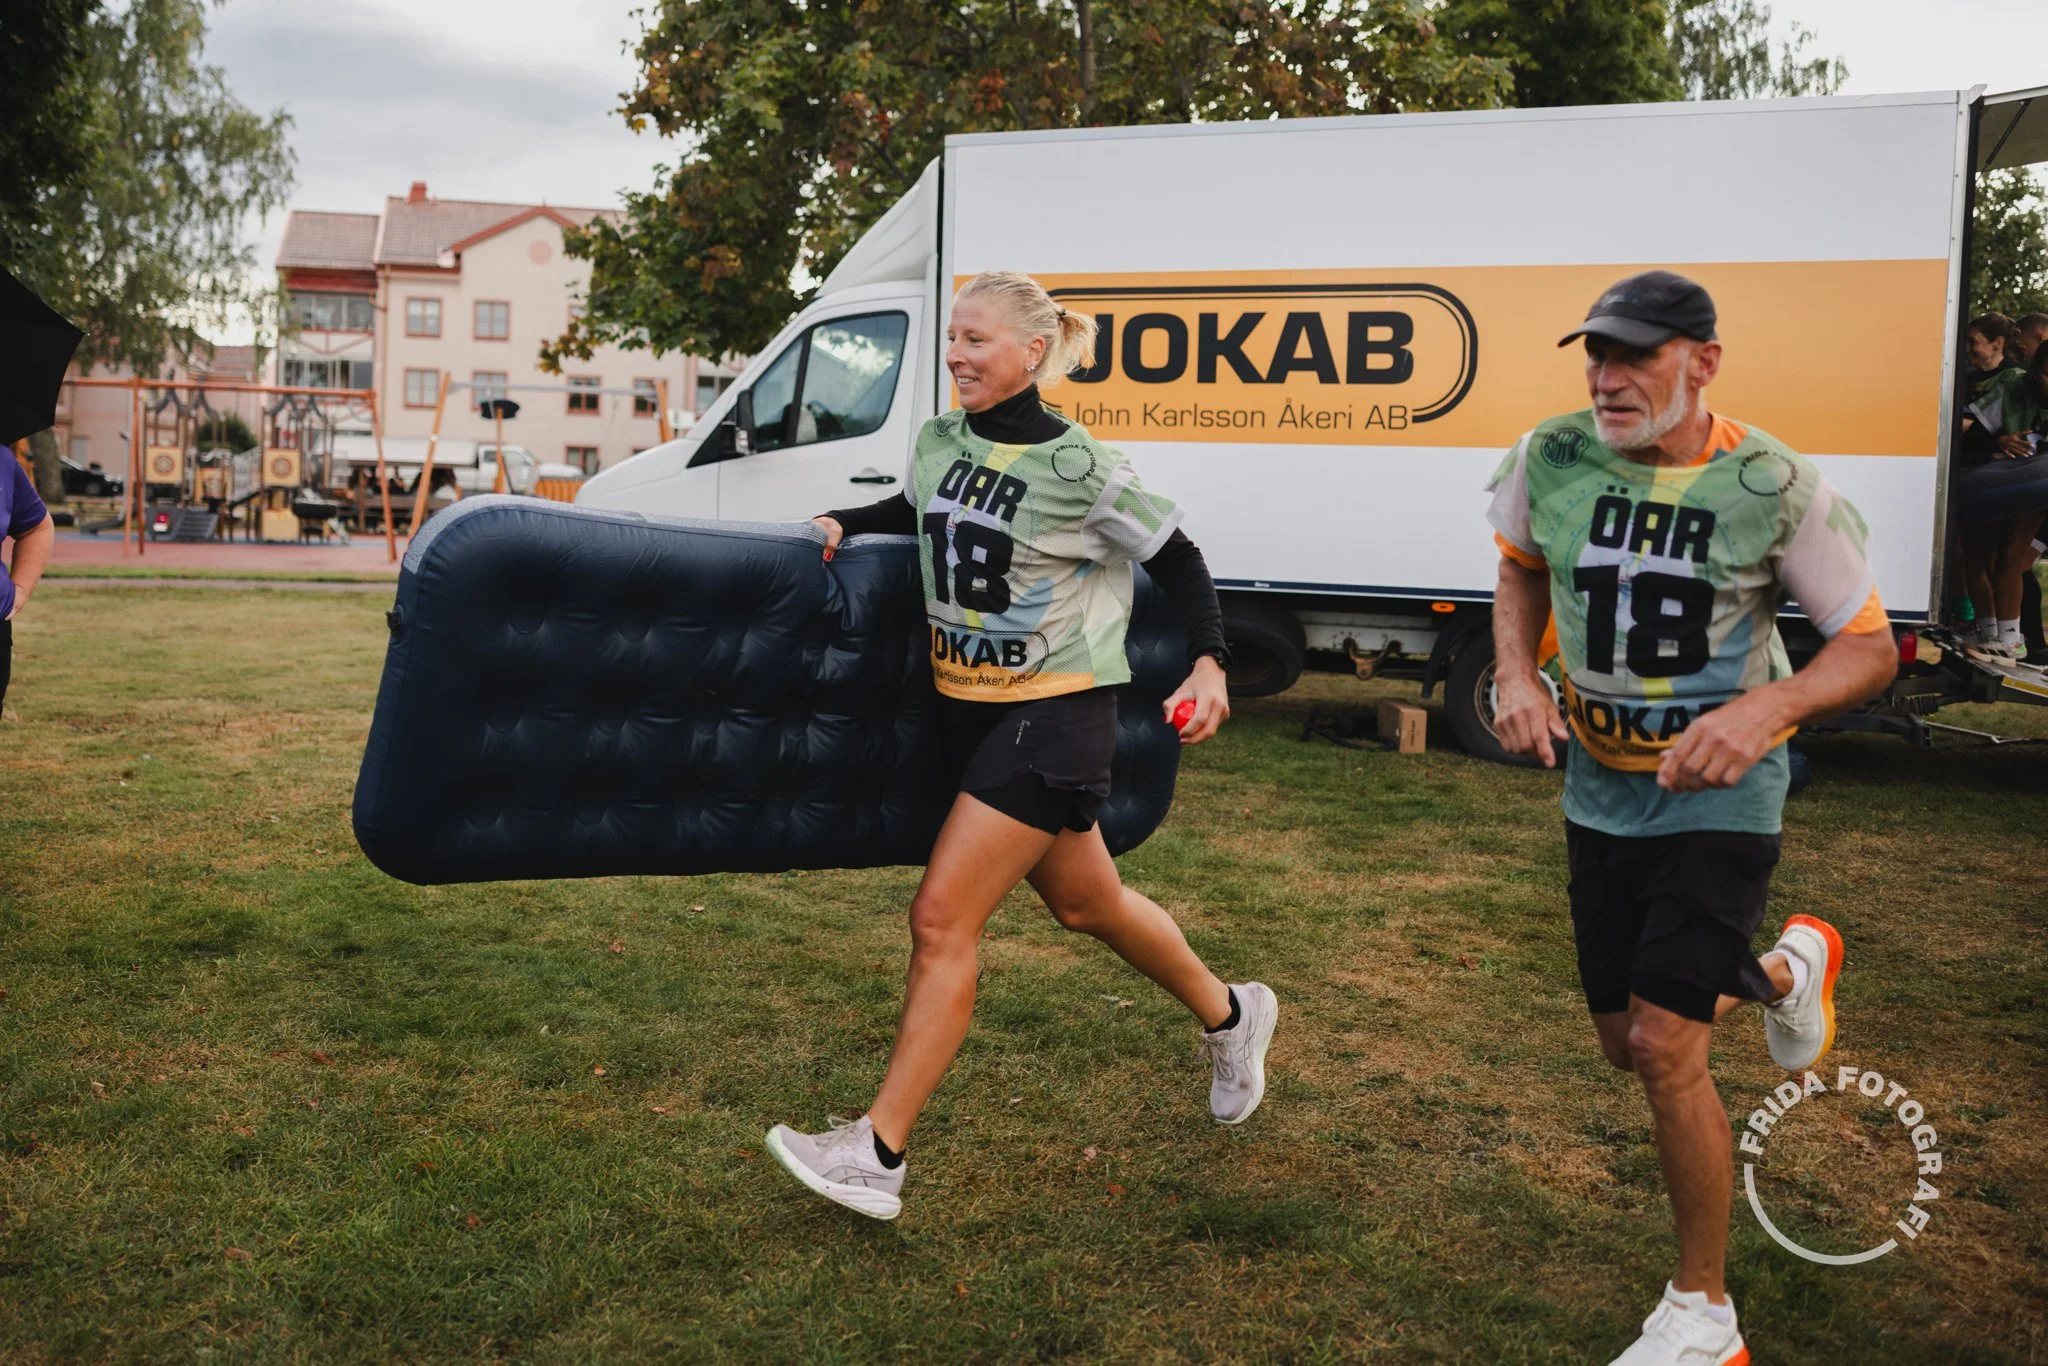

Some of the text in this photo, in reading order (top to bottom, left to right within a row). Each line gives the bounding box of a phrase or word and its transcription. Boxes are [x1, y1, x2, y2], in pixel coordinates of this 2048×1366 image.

[1066, 311, 1414, 385] JOKAB
[1075, 397, 1408, 430] John Karlsson Åkeri AB
[936, 451, 1028, 523] ÖAR
[1055, 444, 1097, 482] FRIDA FOTOGRAFI
[1588, 485, 1717, 564] ÖAR
[922, 511, 1014, 614] 18
[929, 624, 1027, 668] OKAB
[1573, 564, 1715, 678] 18
[977, 672, 1005, 686] Åkeri
[1008, 674, 1026, 684] AB
